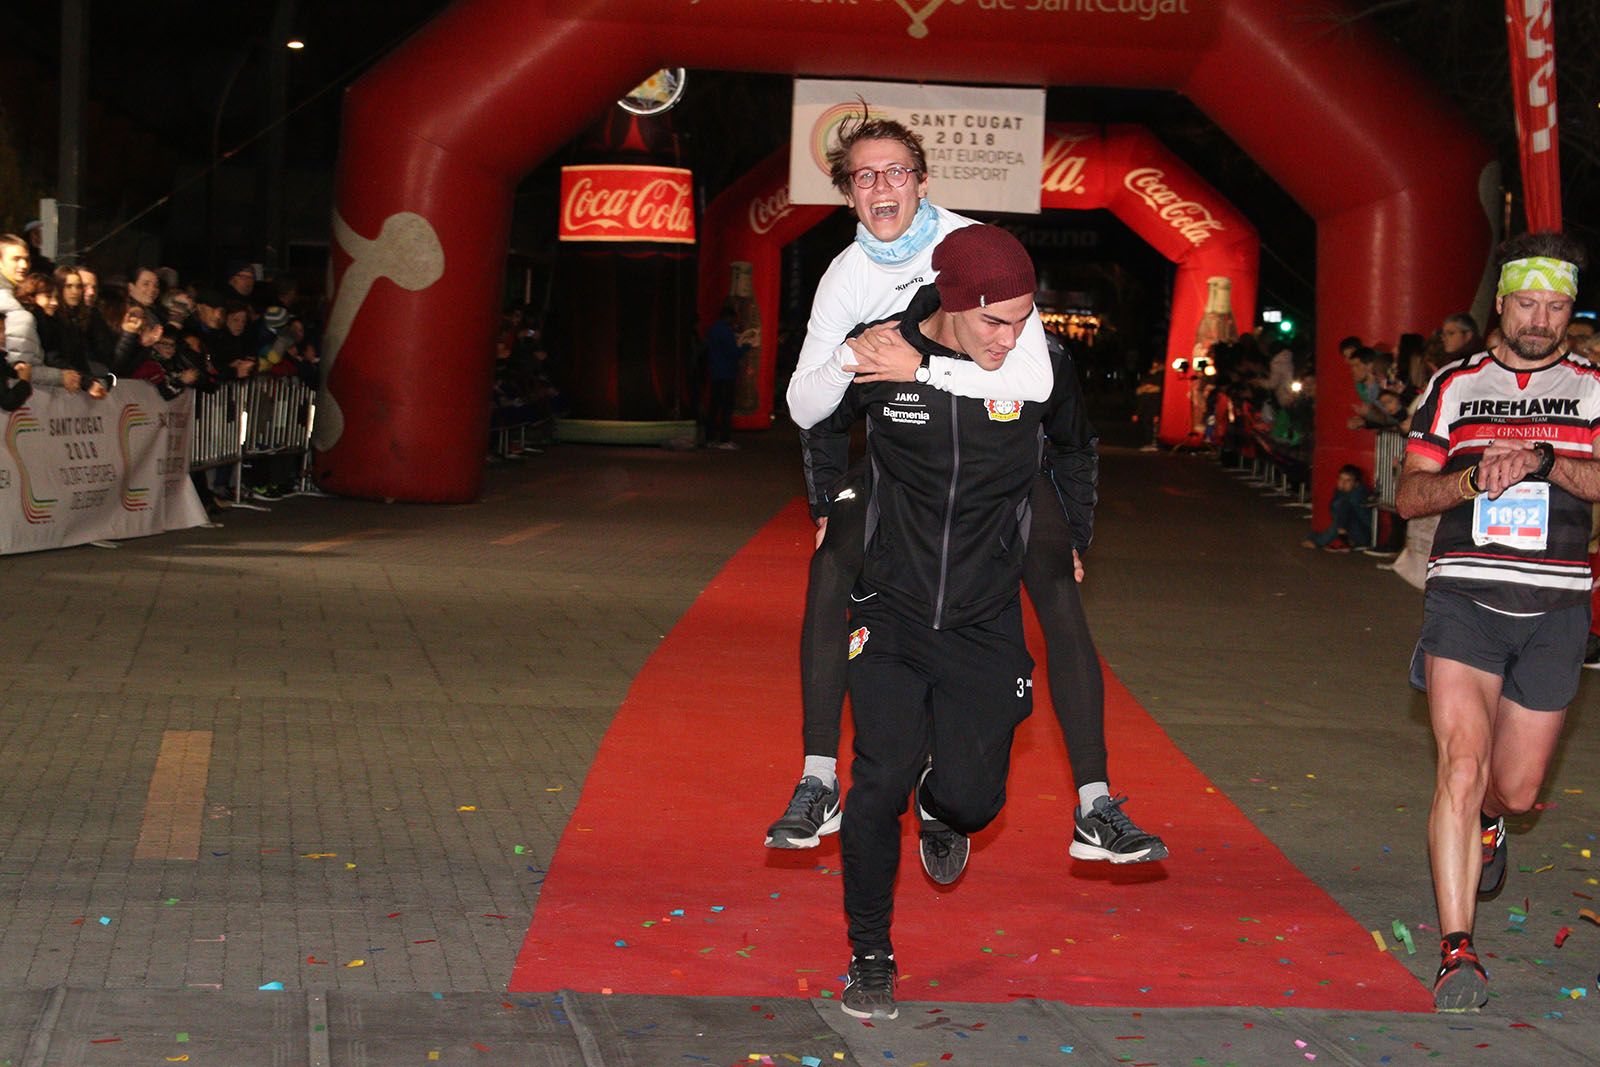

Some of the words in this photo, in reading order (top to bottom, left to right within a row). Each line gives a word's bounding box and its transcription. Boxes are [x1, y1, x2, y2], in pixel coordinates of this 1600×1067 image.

[910, 113, 957, 127] SANT
[965, 115, 1023, 130] CUGAT
[936, 131, 996, 146] 2018
[957, 149, 1025, 165] EUROPEA
[563, 177, 692, 233] Coca-Cola
[1123, 167, 1228, 247] Coca-Cola
[894, 392, 920, 402] JAKO
[883, 406, 930, 420] Barmenia
[1459, 398, 1580, 417] FIREHAWK
[49, 417, 72, 436] SANT
[1497, 426, 1559, 438] GENERALI
[1487, 505, 1541, 526] 1092
[1016, 677, 1025, 698] 3
